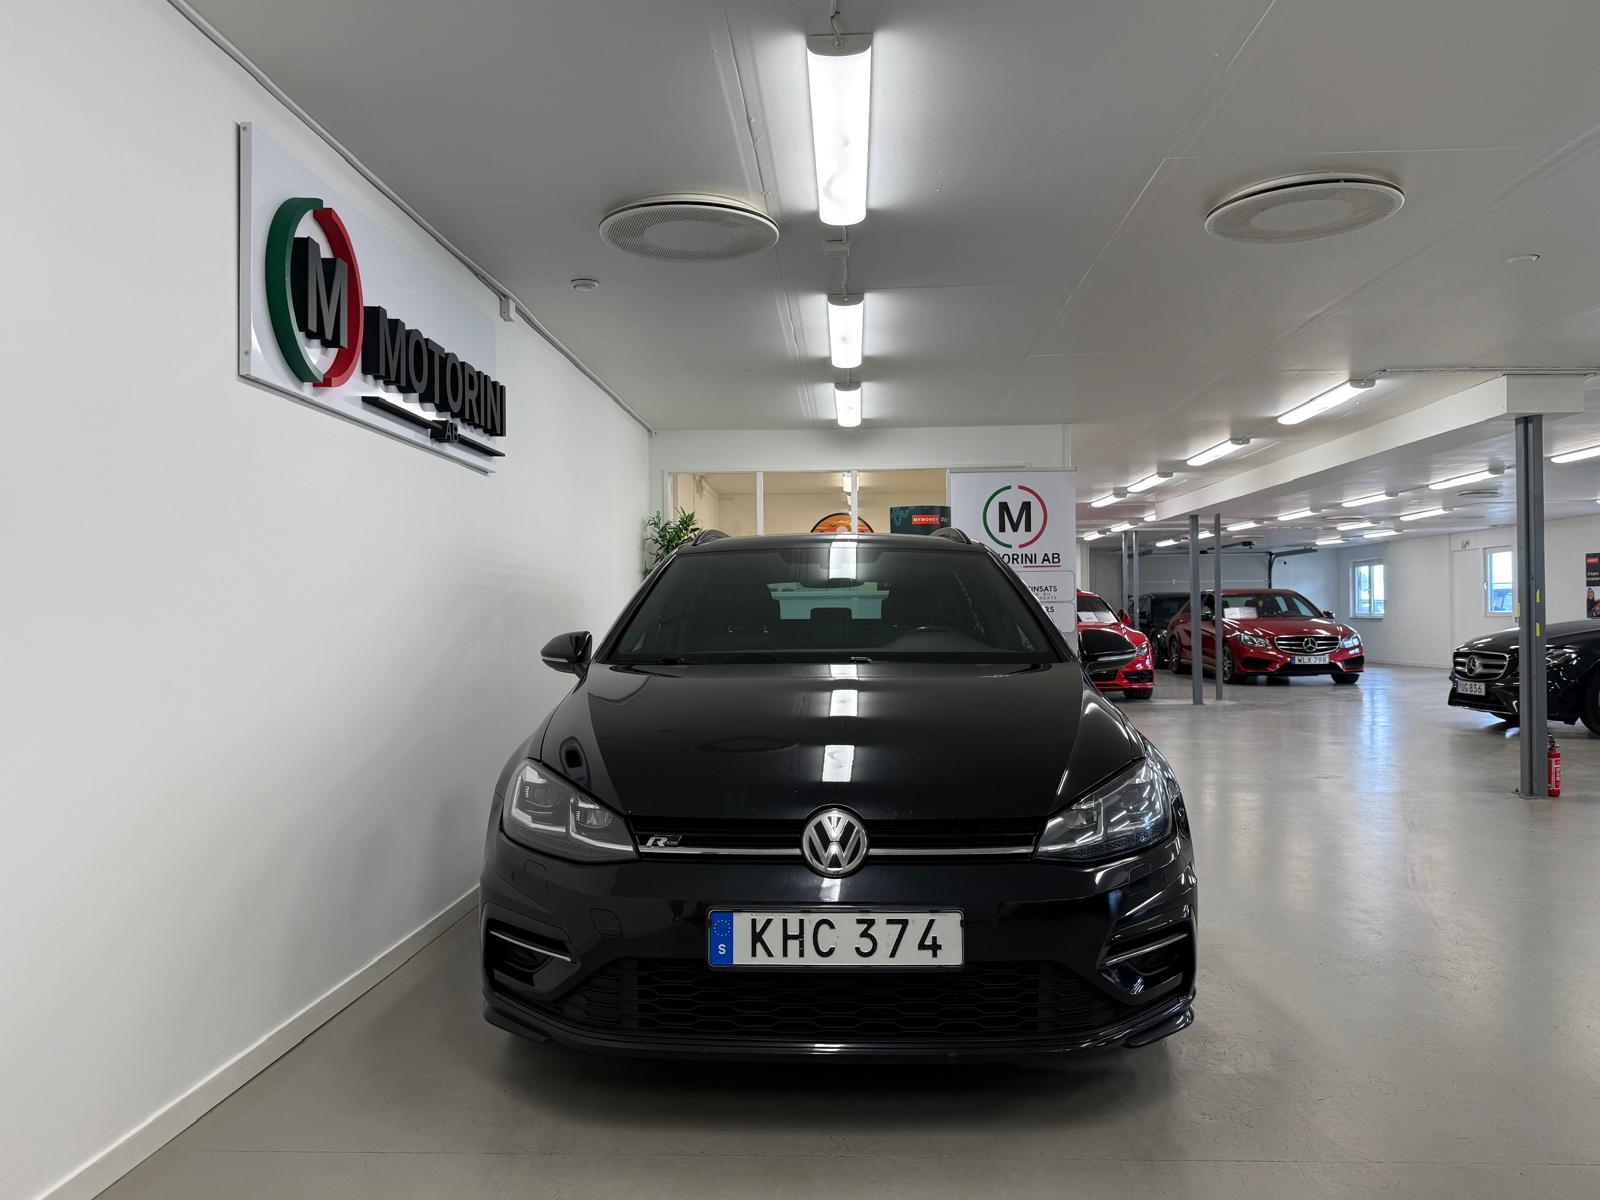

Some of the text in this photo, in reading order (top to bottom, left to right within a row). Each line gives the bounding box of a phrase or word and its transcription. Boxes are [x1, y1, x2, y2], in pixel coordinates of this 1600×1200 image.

[299, 237, 348, 349] M
[371, 306, 506, 436] MOTORINI
[998, 501, 1032, 533] M
[1000, 552, 1061, 565] ORINI AB
[1029, 585, 1058, 593] INSATS
[1469, 683, 1483, 694] 836
[717, 943, 727, 955] S
[750, 918, 942, 958] KHC 374
